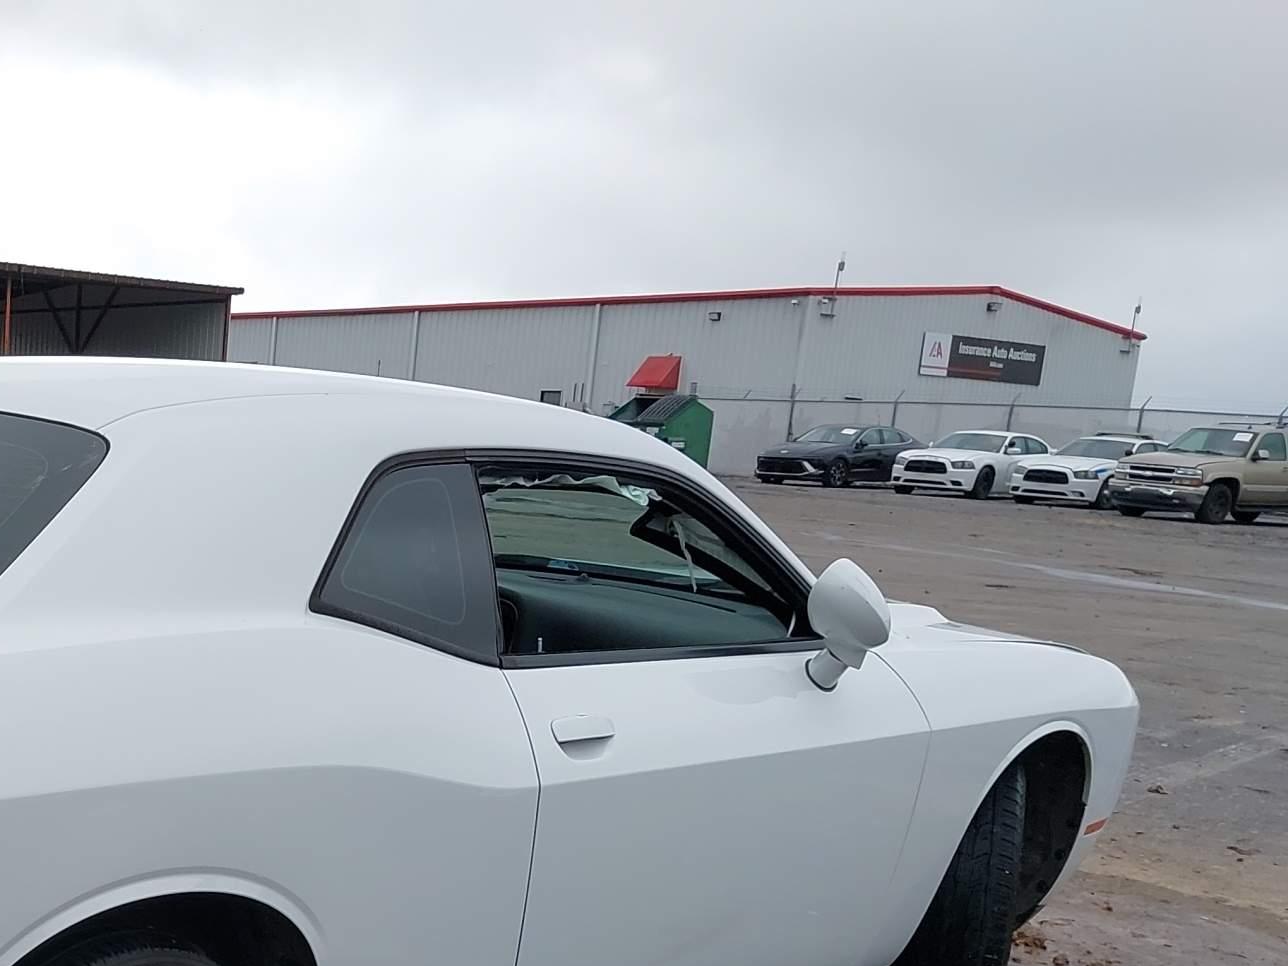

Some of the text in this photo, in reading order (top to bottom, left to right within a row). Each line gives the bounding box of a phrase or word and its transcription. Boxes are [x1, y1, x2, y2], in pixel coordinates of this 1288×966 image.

[958, 342, 1037, 362] Insurance Auto Auctions
